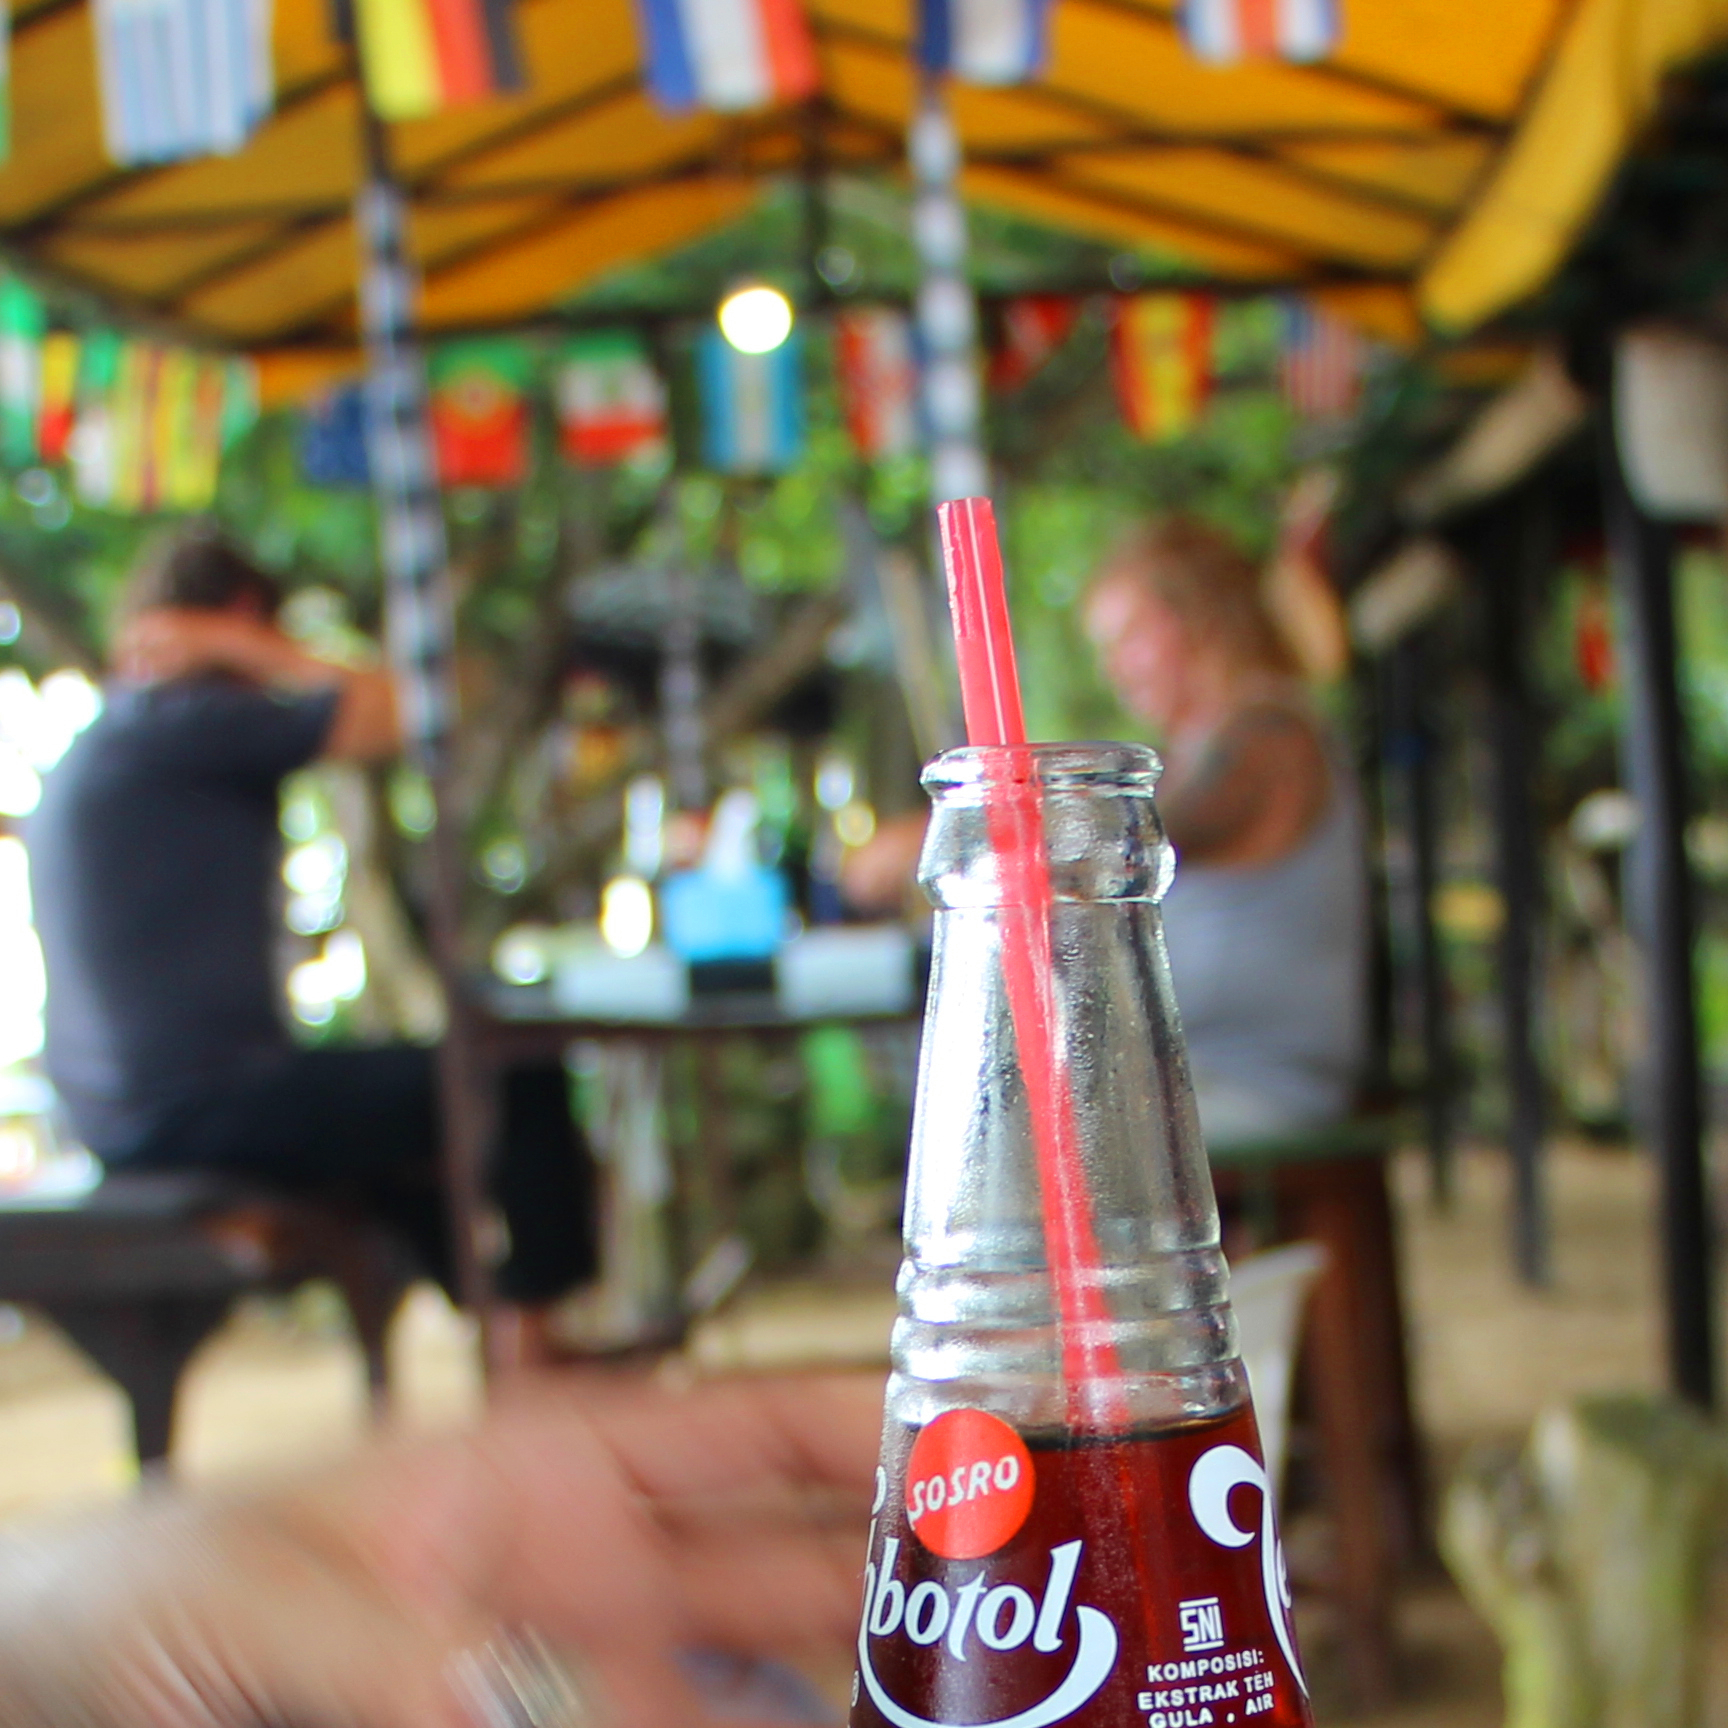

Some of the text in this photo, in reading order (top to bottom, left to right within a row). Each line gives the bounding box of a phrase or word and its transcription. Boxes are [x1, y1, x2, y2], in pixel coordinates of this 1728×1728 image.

[909, 1454, 1020, 1530] SOSRO
[1179, 1603, 1224, 1644] SNI
[1147, 1649, 1264, 1682] KOMPOSISI:
[1138, 1671, 1274, 1710] EKSTRAK TEH
[1245, 1693, 1274, 1715] AIR
